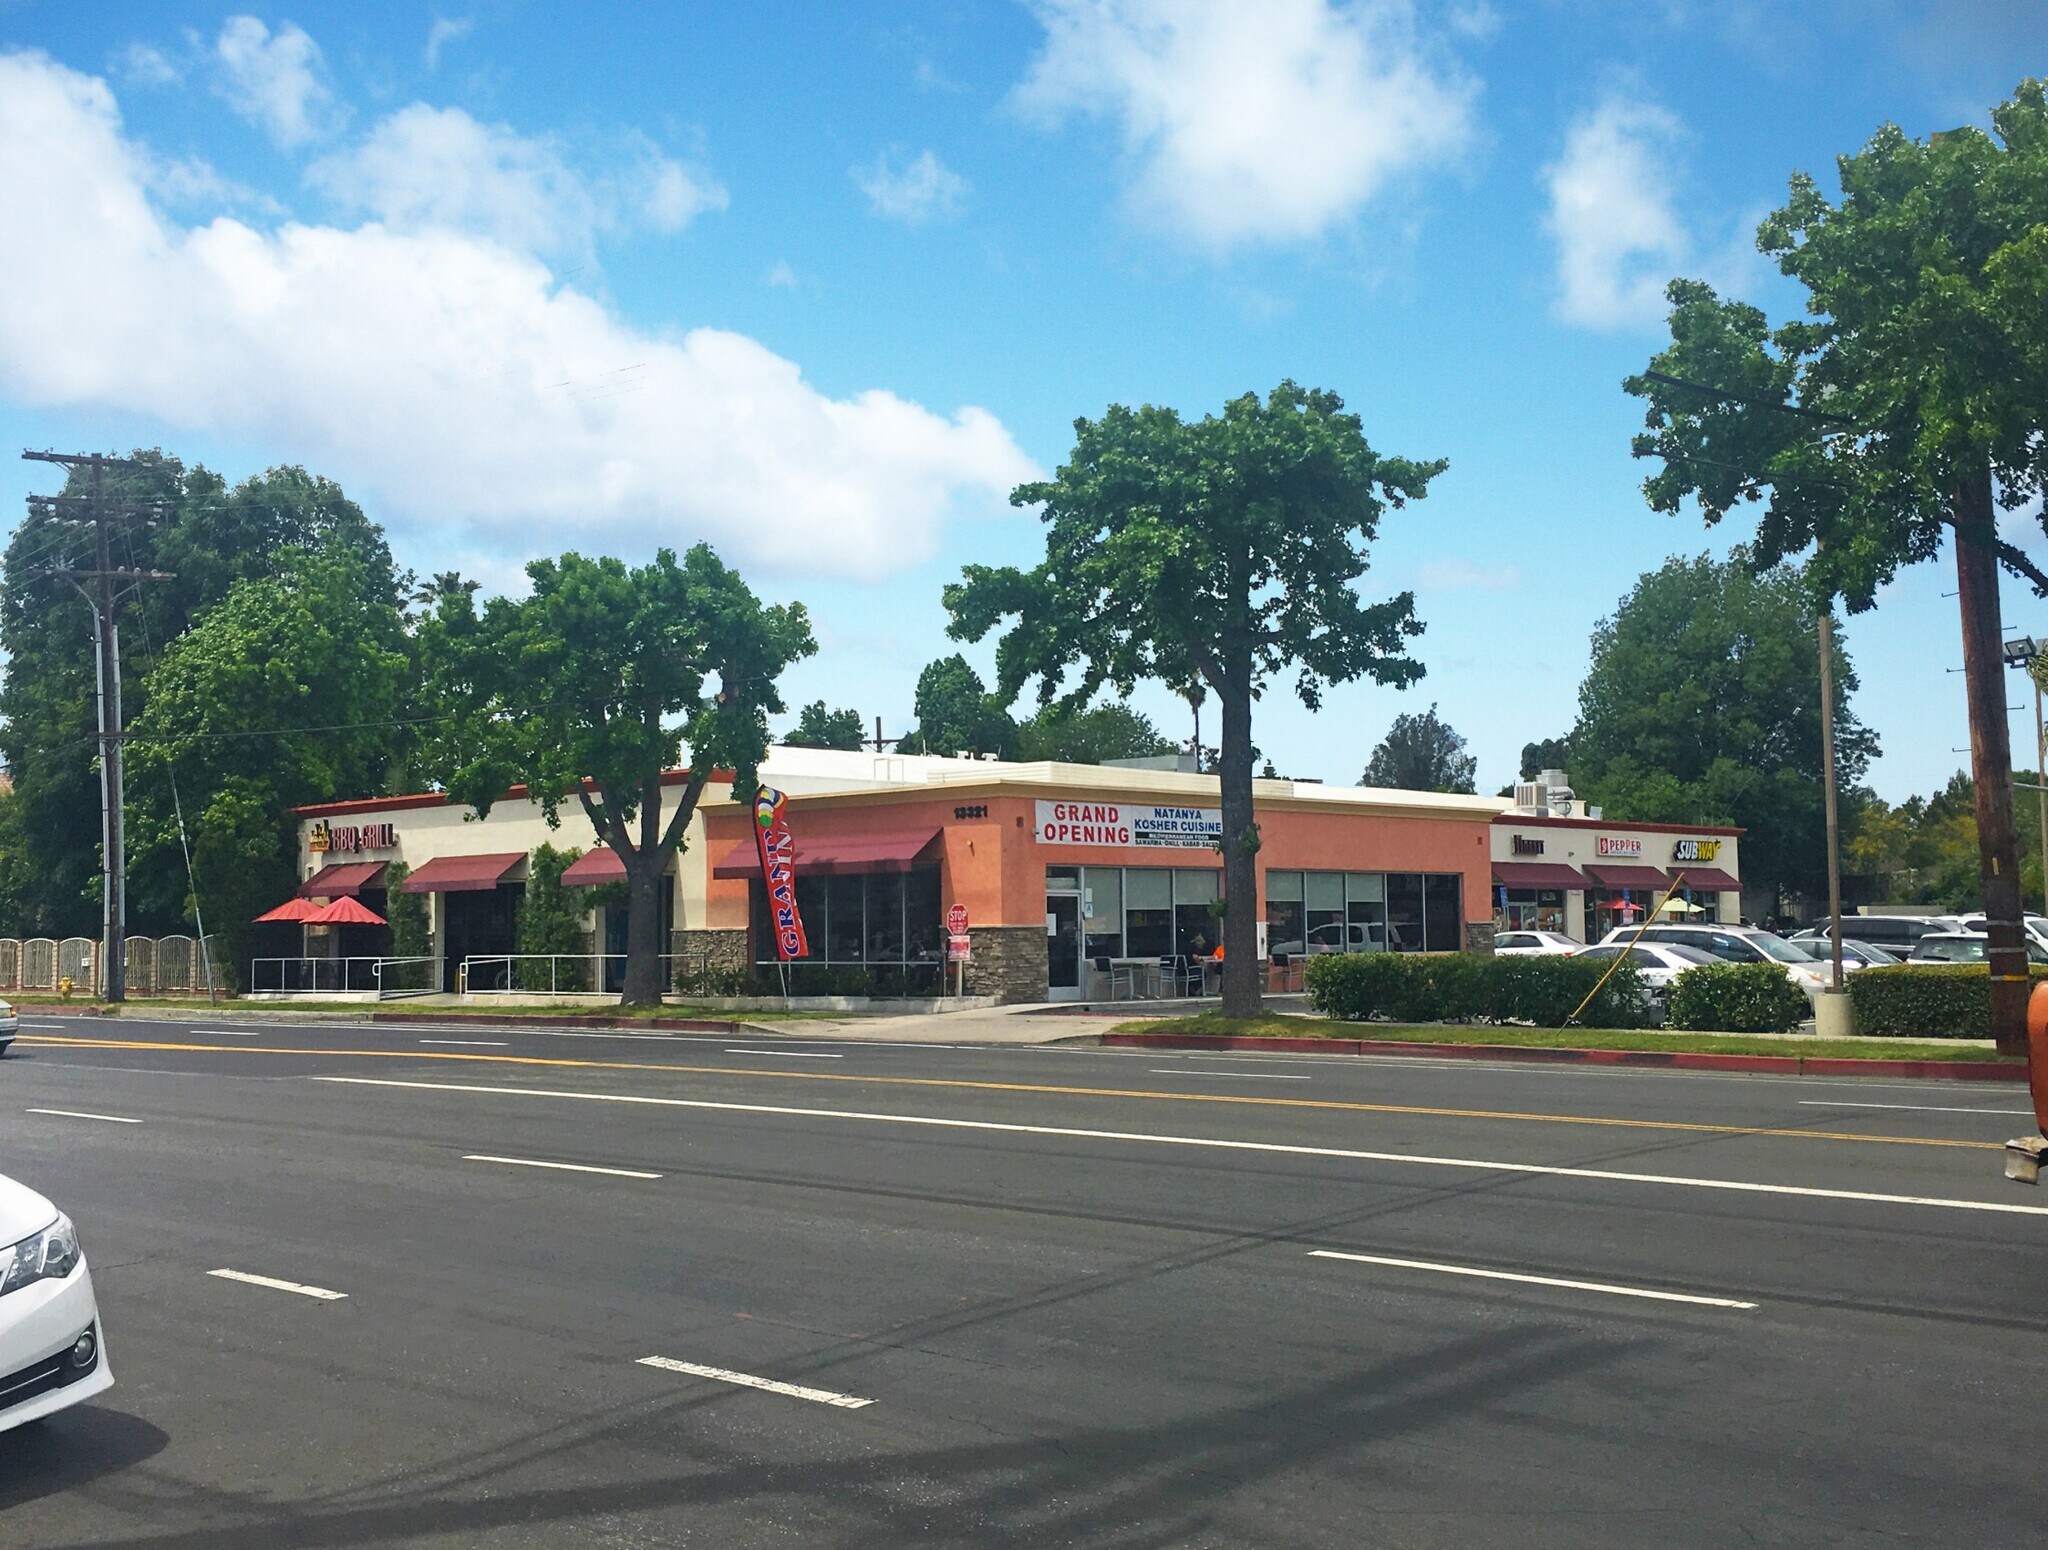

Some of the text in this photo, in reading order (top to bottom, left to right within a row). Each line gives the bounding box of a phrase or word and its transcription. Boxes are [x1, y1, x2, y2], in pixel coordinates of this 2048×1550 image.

[1054, 803, 1119, 824] GRAND
[1154, 807, 1203, 820] NATANYA
[1044, 823, 1130, 844] OPENING
[1134, 818, 1222, 832] KOSHER CUISINE
[332, 823, 393, 853] BBQ GRILL
[1610, 839, 1642, 852] PEPPER
[1677, 839, 1722, 861] SUBWAY
[950, 911, 967, 922] STOP
